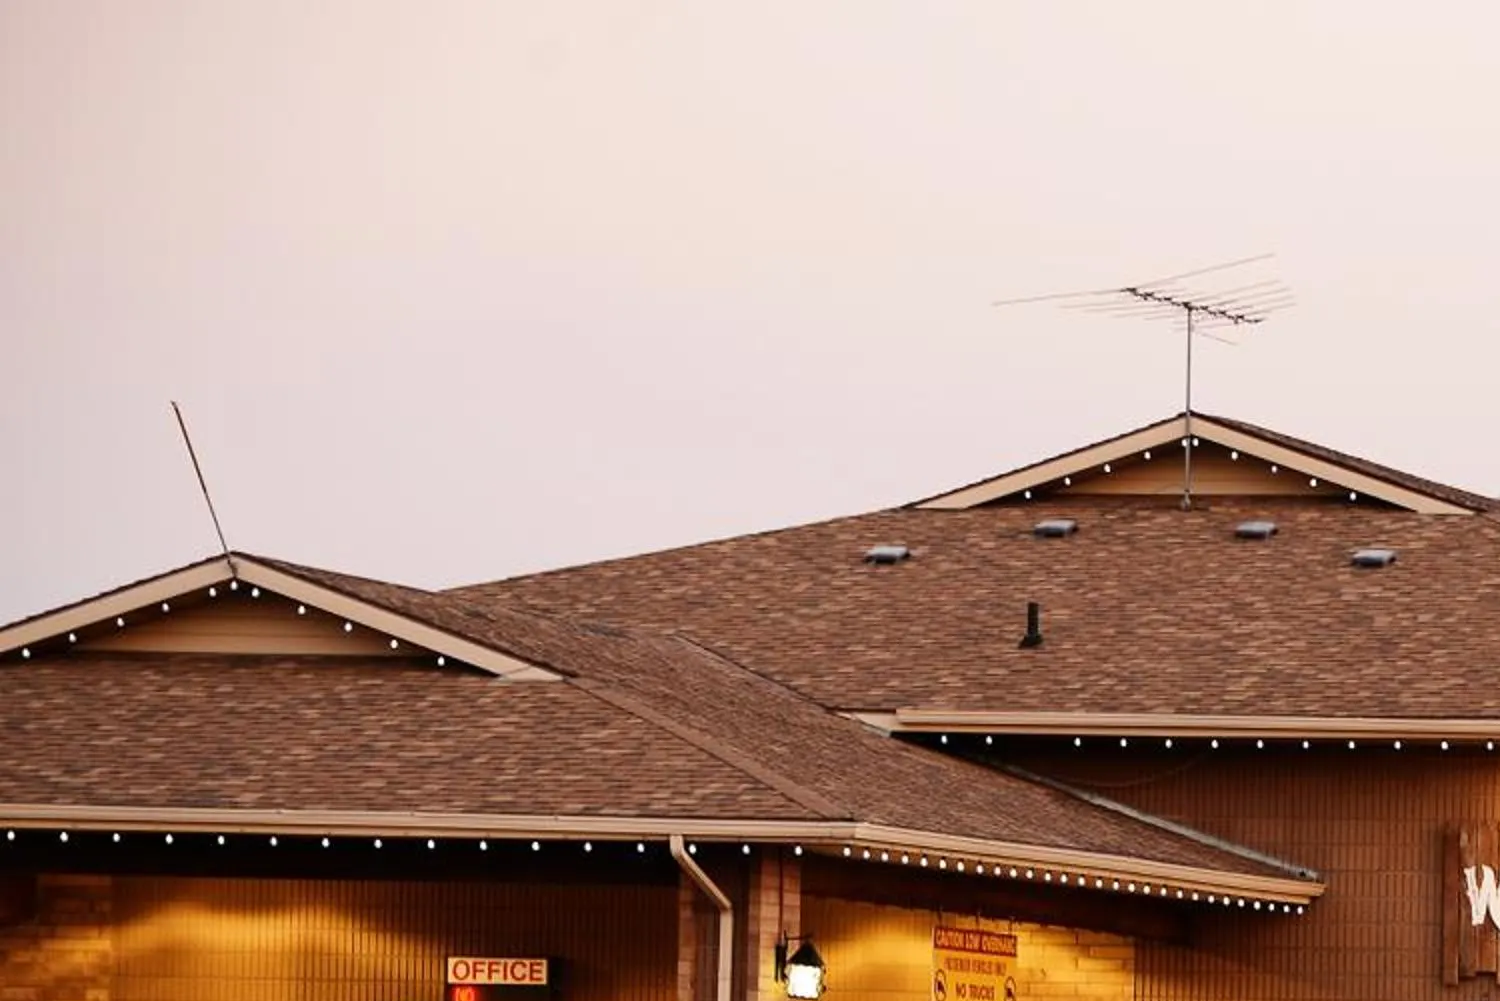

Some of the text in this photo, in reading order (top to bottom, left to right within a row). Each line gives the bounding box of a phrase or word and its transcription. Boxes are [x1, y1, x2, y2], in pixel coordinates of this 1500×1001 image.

[935, 928, 964, 948] CAUTION
[965, 931, 980, 950] LOW
[452, 959, 544, 982] OFFICE
[955, 982, 995, 1001] NO TRUCKS
